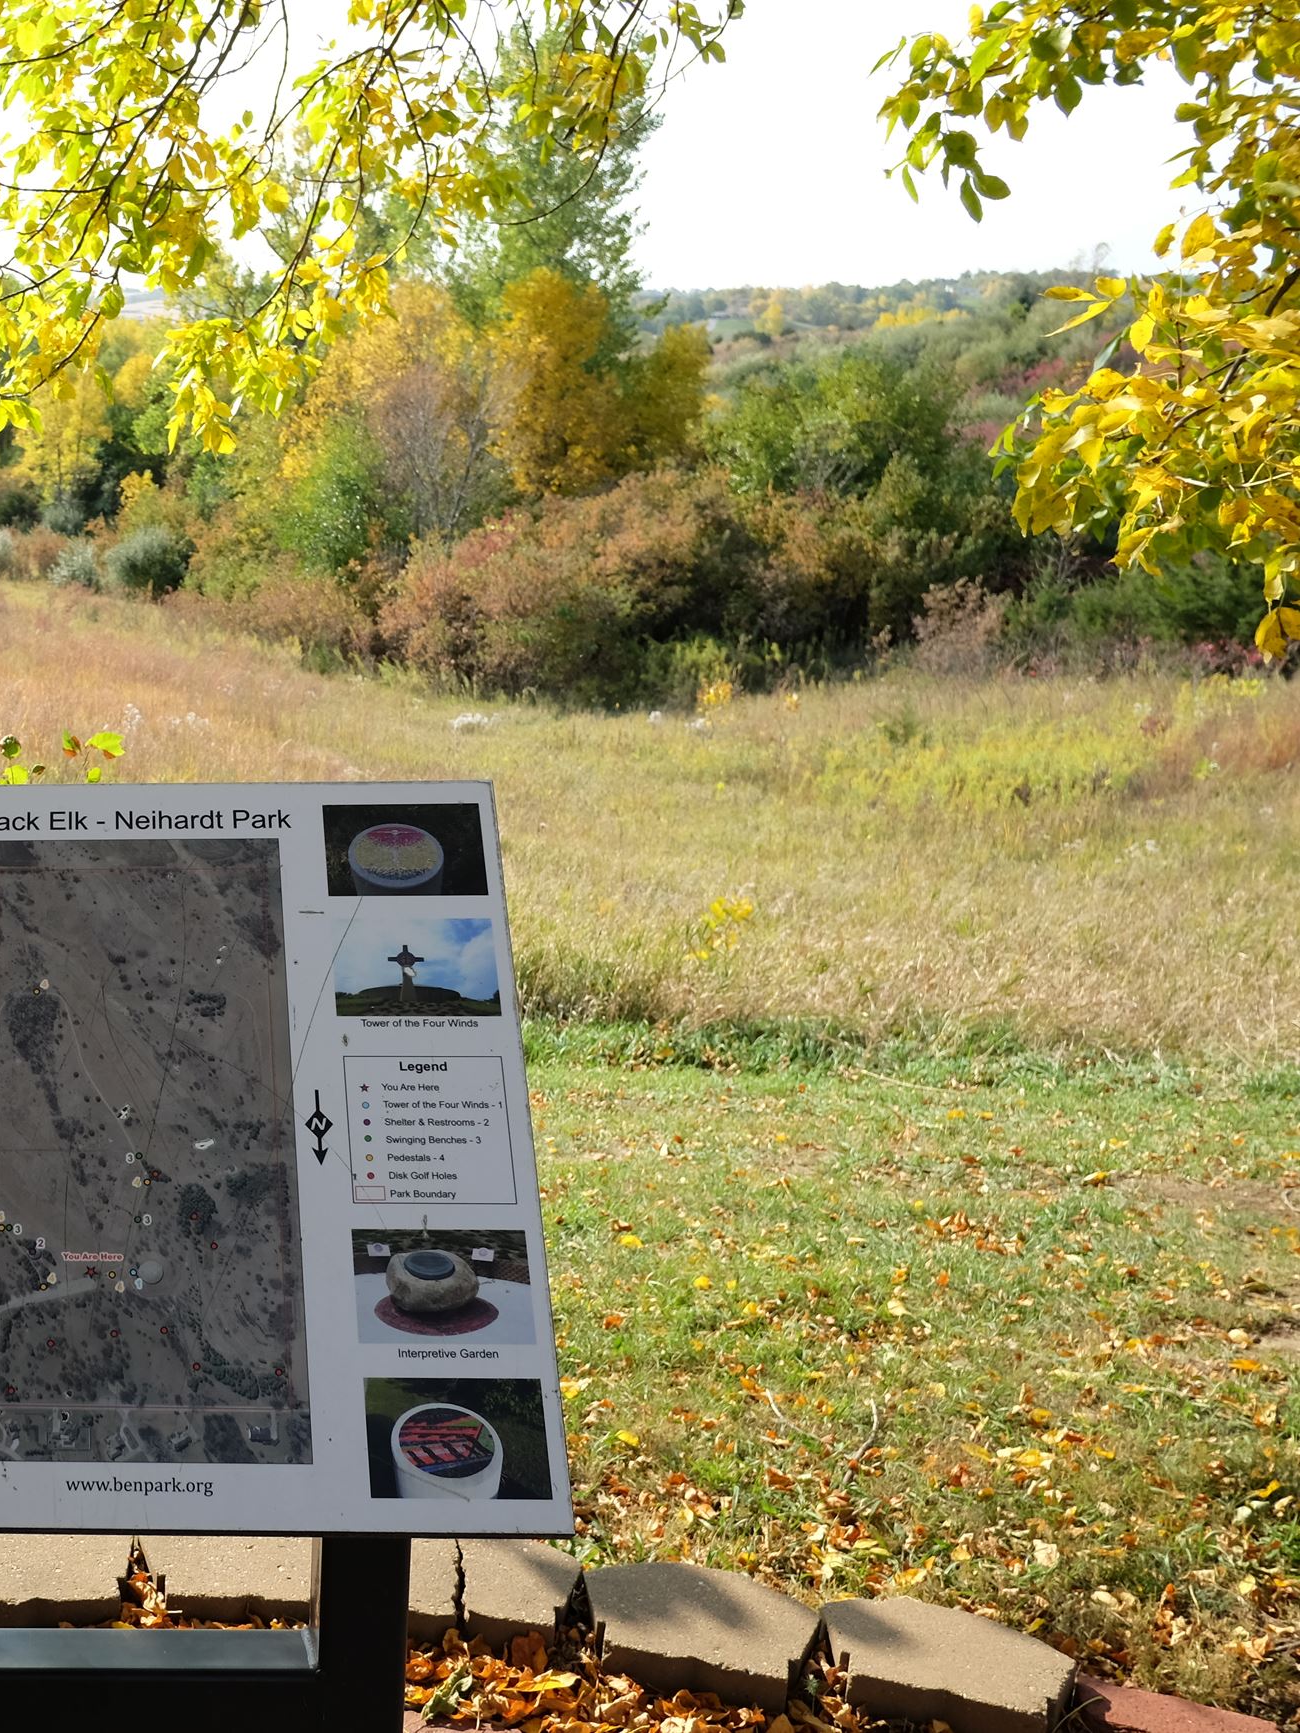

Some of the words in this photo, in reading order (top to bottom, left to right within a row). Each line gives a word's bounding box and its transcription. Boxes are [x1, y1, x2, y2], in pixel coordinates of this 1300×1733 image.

[50, 811, 88, 830] Elk
[116, 810, 223, 830] Neihardt
[233, 810, 291, 829] Park
[361, 1019, 389, 1028] Tower
[392, 1019, 402, 1028] of
[405, 1019, 420, 1028] the
[423, 1019, 445, 1028] Four
[448, 1019, 478, 1028] Winds
[399, 1061, 447, 1074] Legend
[381, 1083, 398, 1092] You
[400, 1084, 415, 1092] Are
[419, 1084, 439, 1092] Here
[383, 1101, 409, 1109] Tower
[412, 1101, 420, 1109] of
[423, 1101, 436, 1109] the
[439, 1101, 459, 1109] Four
[461, 1101, 489, 1109] Winds
[310, 1118, 327, 1130] N
[385, 1118, 415, 1127] Shelter
[417, 1117, 426, 1127] &
[428, 1118, 475, 1127] Restrooms
[386, 1136, 426, 1146] Swinging
[429, 1136, 467, 1145] Benches
[388, 1154, 431, 1162] Pedestals
[389, 1171, 408, 1180] Disk
[411, 1172, 429, 1180] Golf
[432, 1172, 457, 1181] Holes
[390, 1190, 411, 1199] Park
[413, 1190, 456, 1201] Boundary
[398, 1349, 456, 1361] Interpretive
[460, 1349, 499, 1359] Garden
[66, 1477, 213, 1497] www.benpark.org
